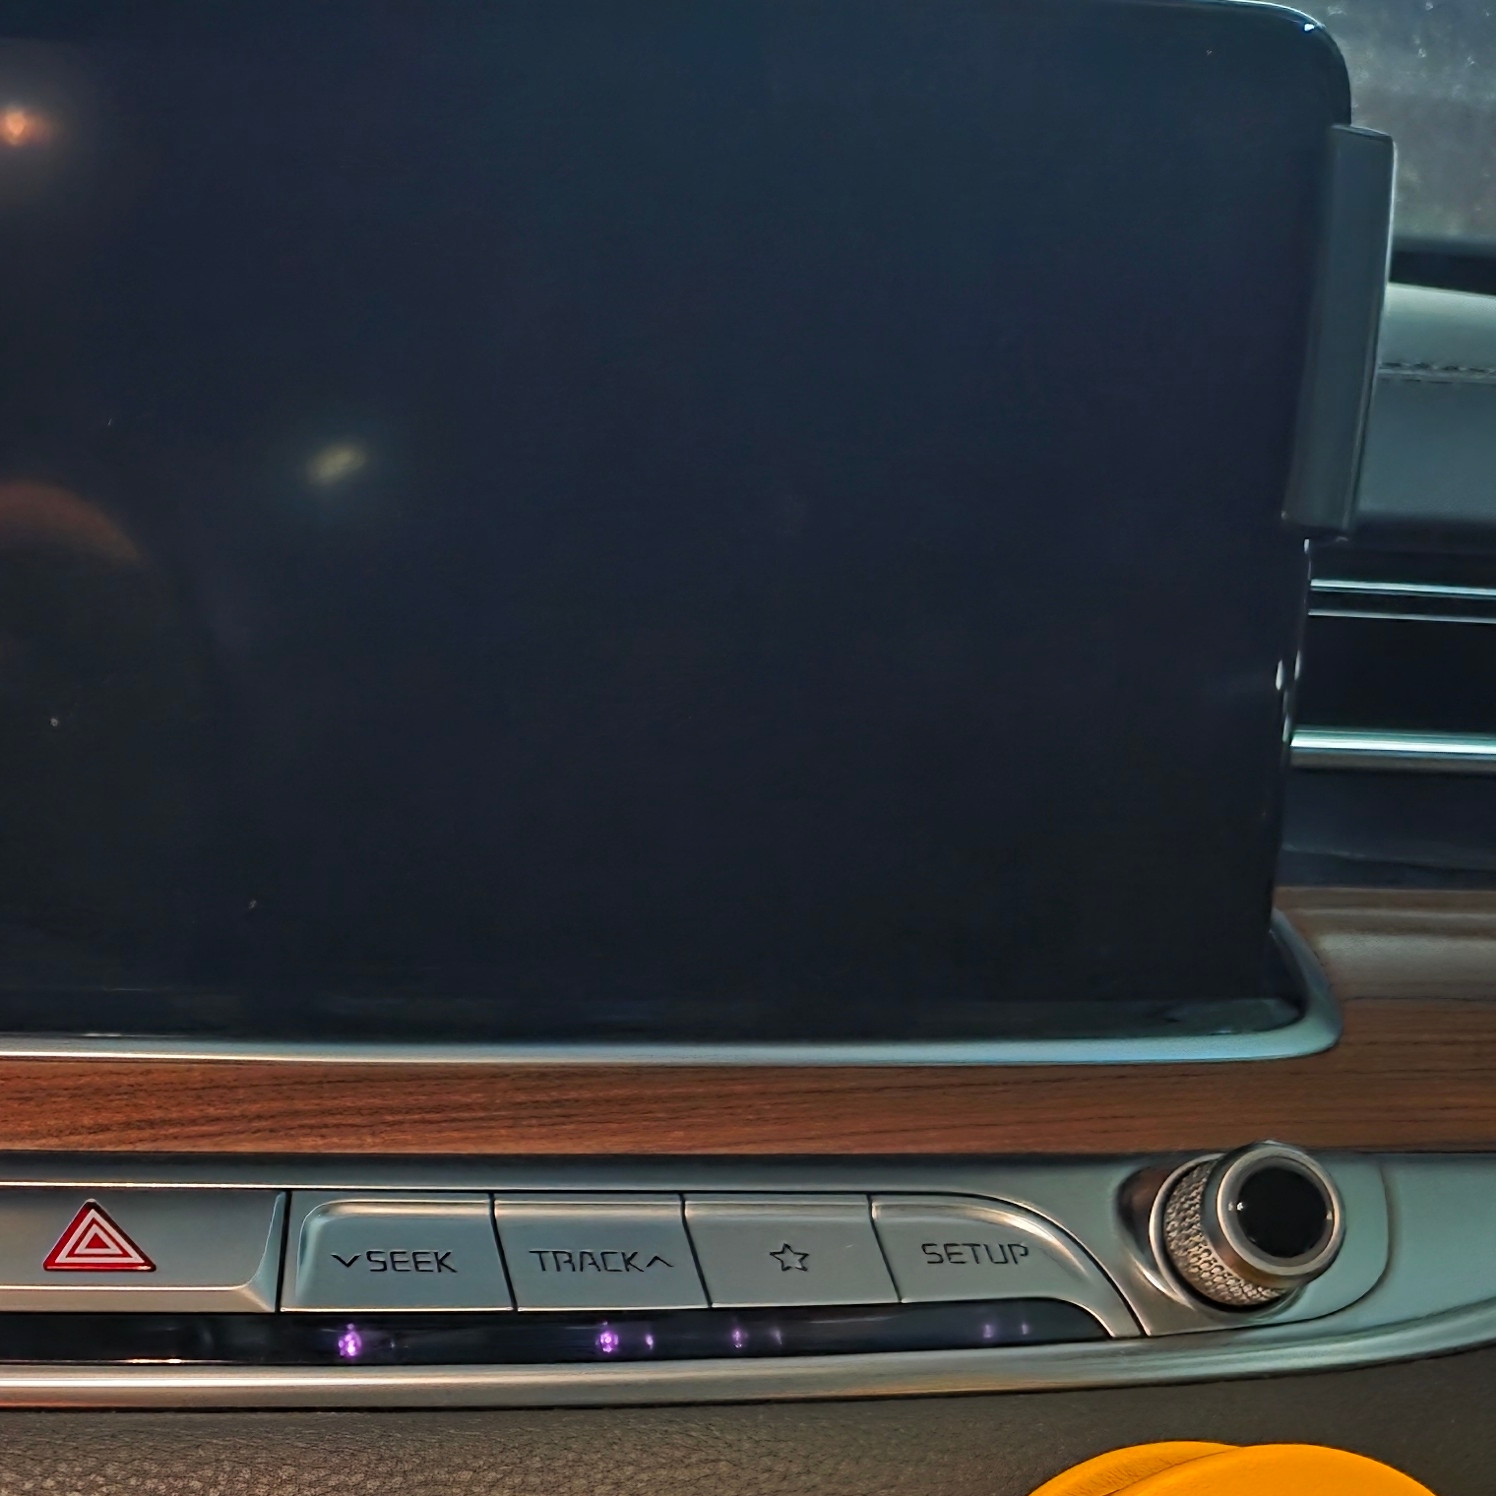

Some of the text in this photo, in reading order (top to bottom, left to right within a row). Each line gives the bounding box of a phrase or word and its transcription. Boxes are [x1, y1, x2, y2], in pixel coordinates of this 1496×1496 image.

[366, 1249, 457, 1274] SEEK
[528, 1250, 644, 1273] TRACK
[920, 1241, 1030, 1267] SETUP
